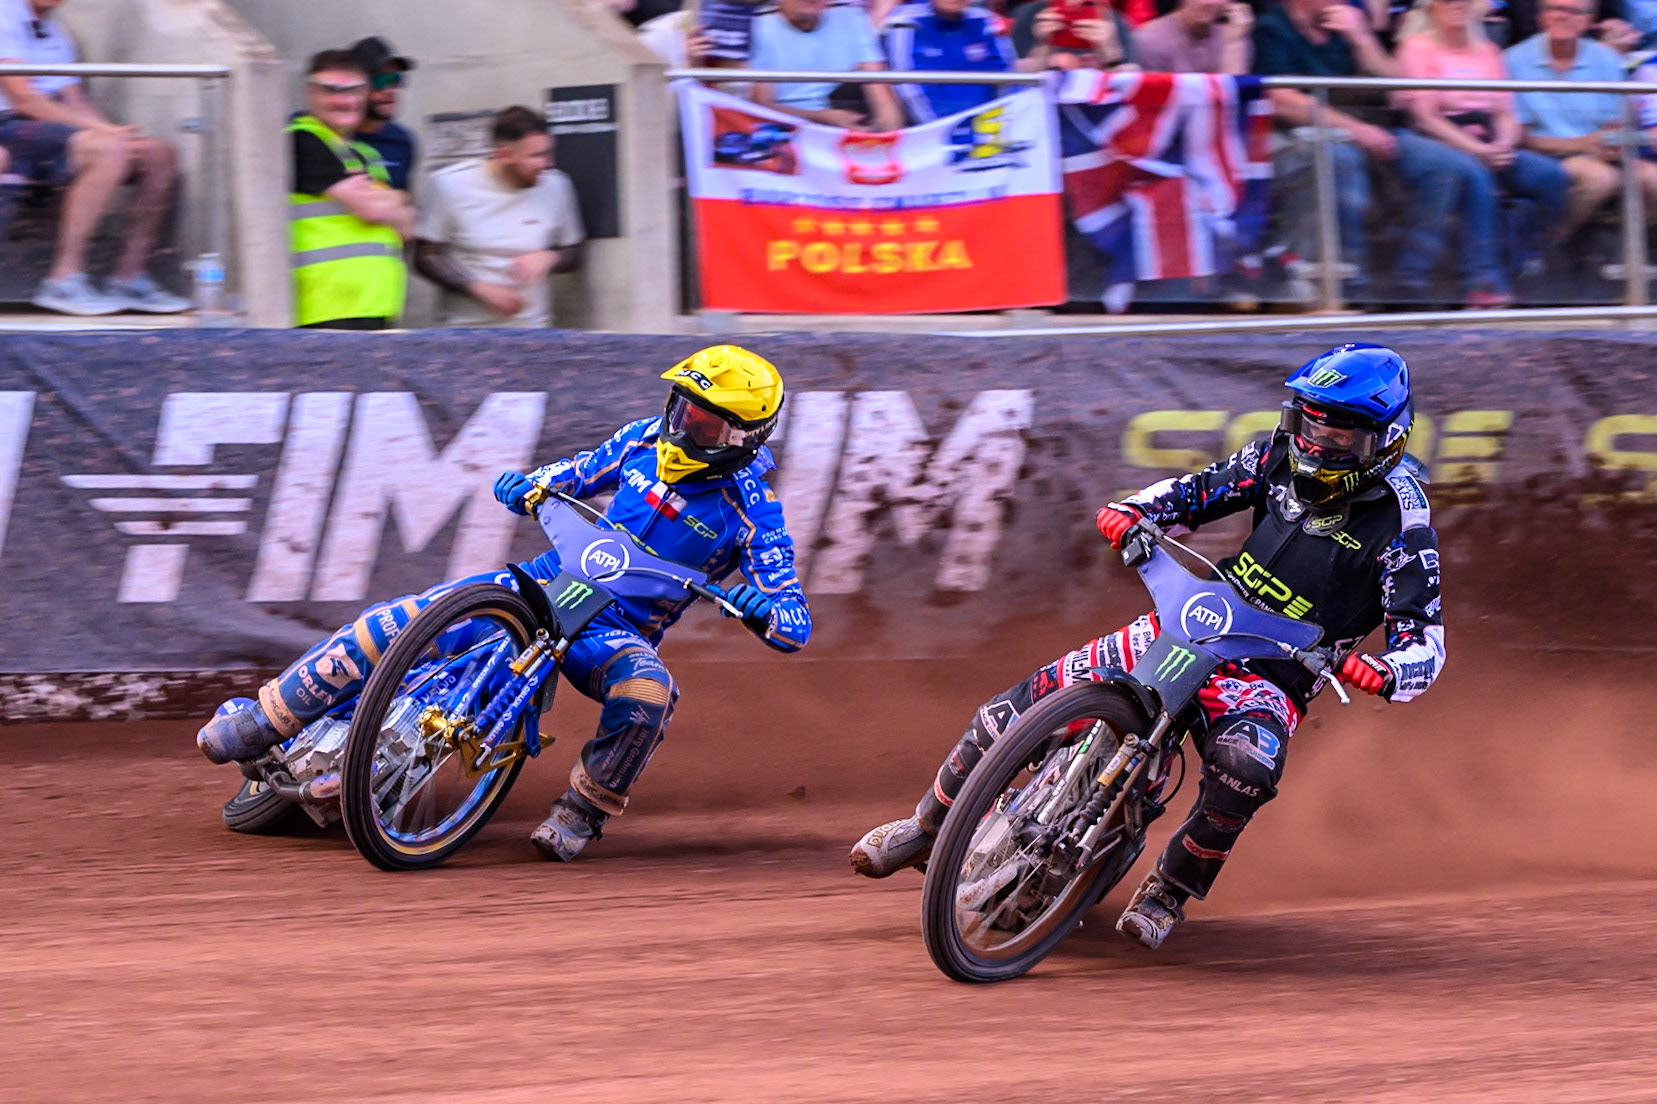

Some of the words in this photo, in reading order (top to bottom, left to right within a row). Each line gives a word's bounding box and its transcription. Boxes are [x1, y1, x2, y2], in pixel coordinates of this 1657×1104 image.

[766, 240, 973, 274] POLSKA
[677, 369, 711, 390] MCG
[61, 391, 548, 603] FIM
[766, 390, 1036, 595] IM
[683, 515, 718, 540] SGP
[1311, 514, 1343, 529] SGP
[588, 549, 621, 572] ATPI
[1188, 604, 1224, 631] ATPI
[296, 687, 311, 706] OIL
[298, 665, 336, 706] ORLEN
[1219, 773, 1260, 797] ANLAS
